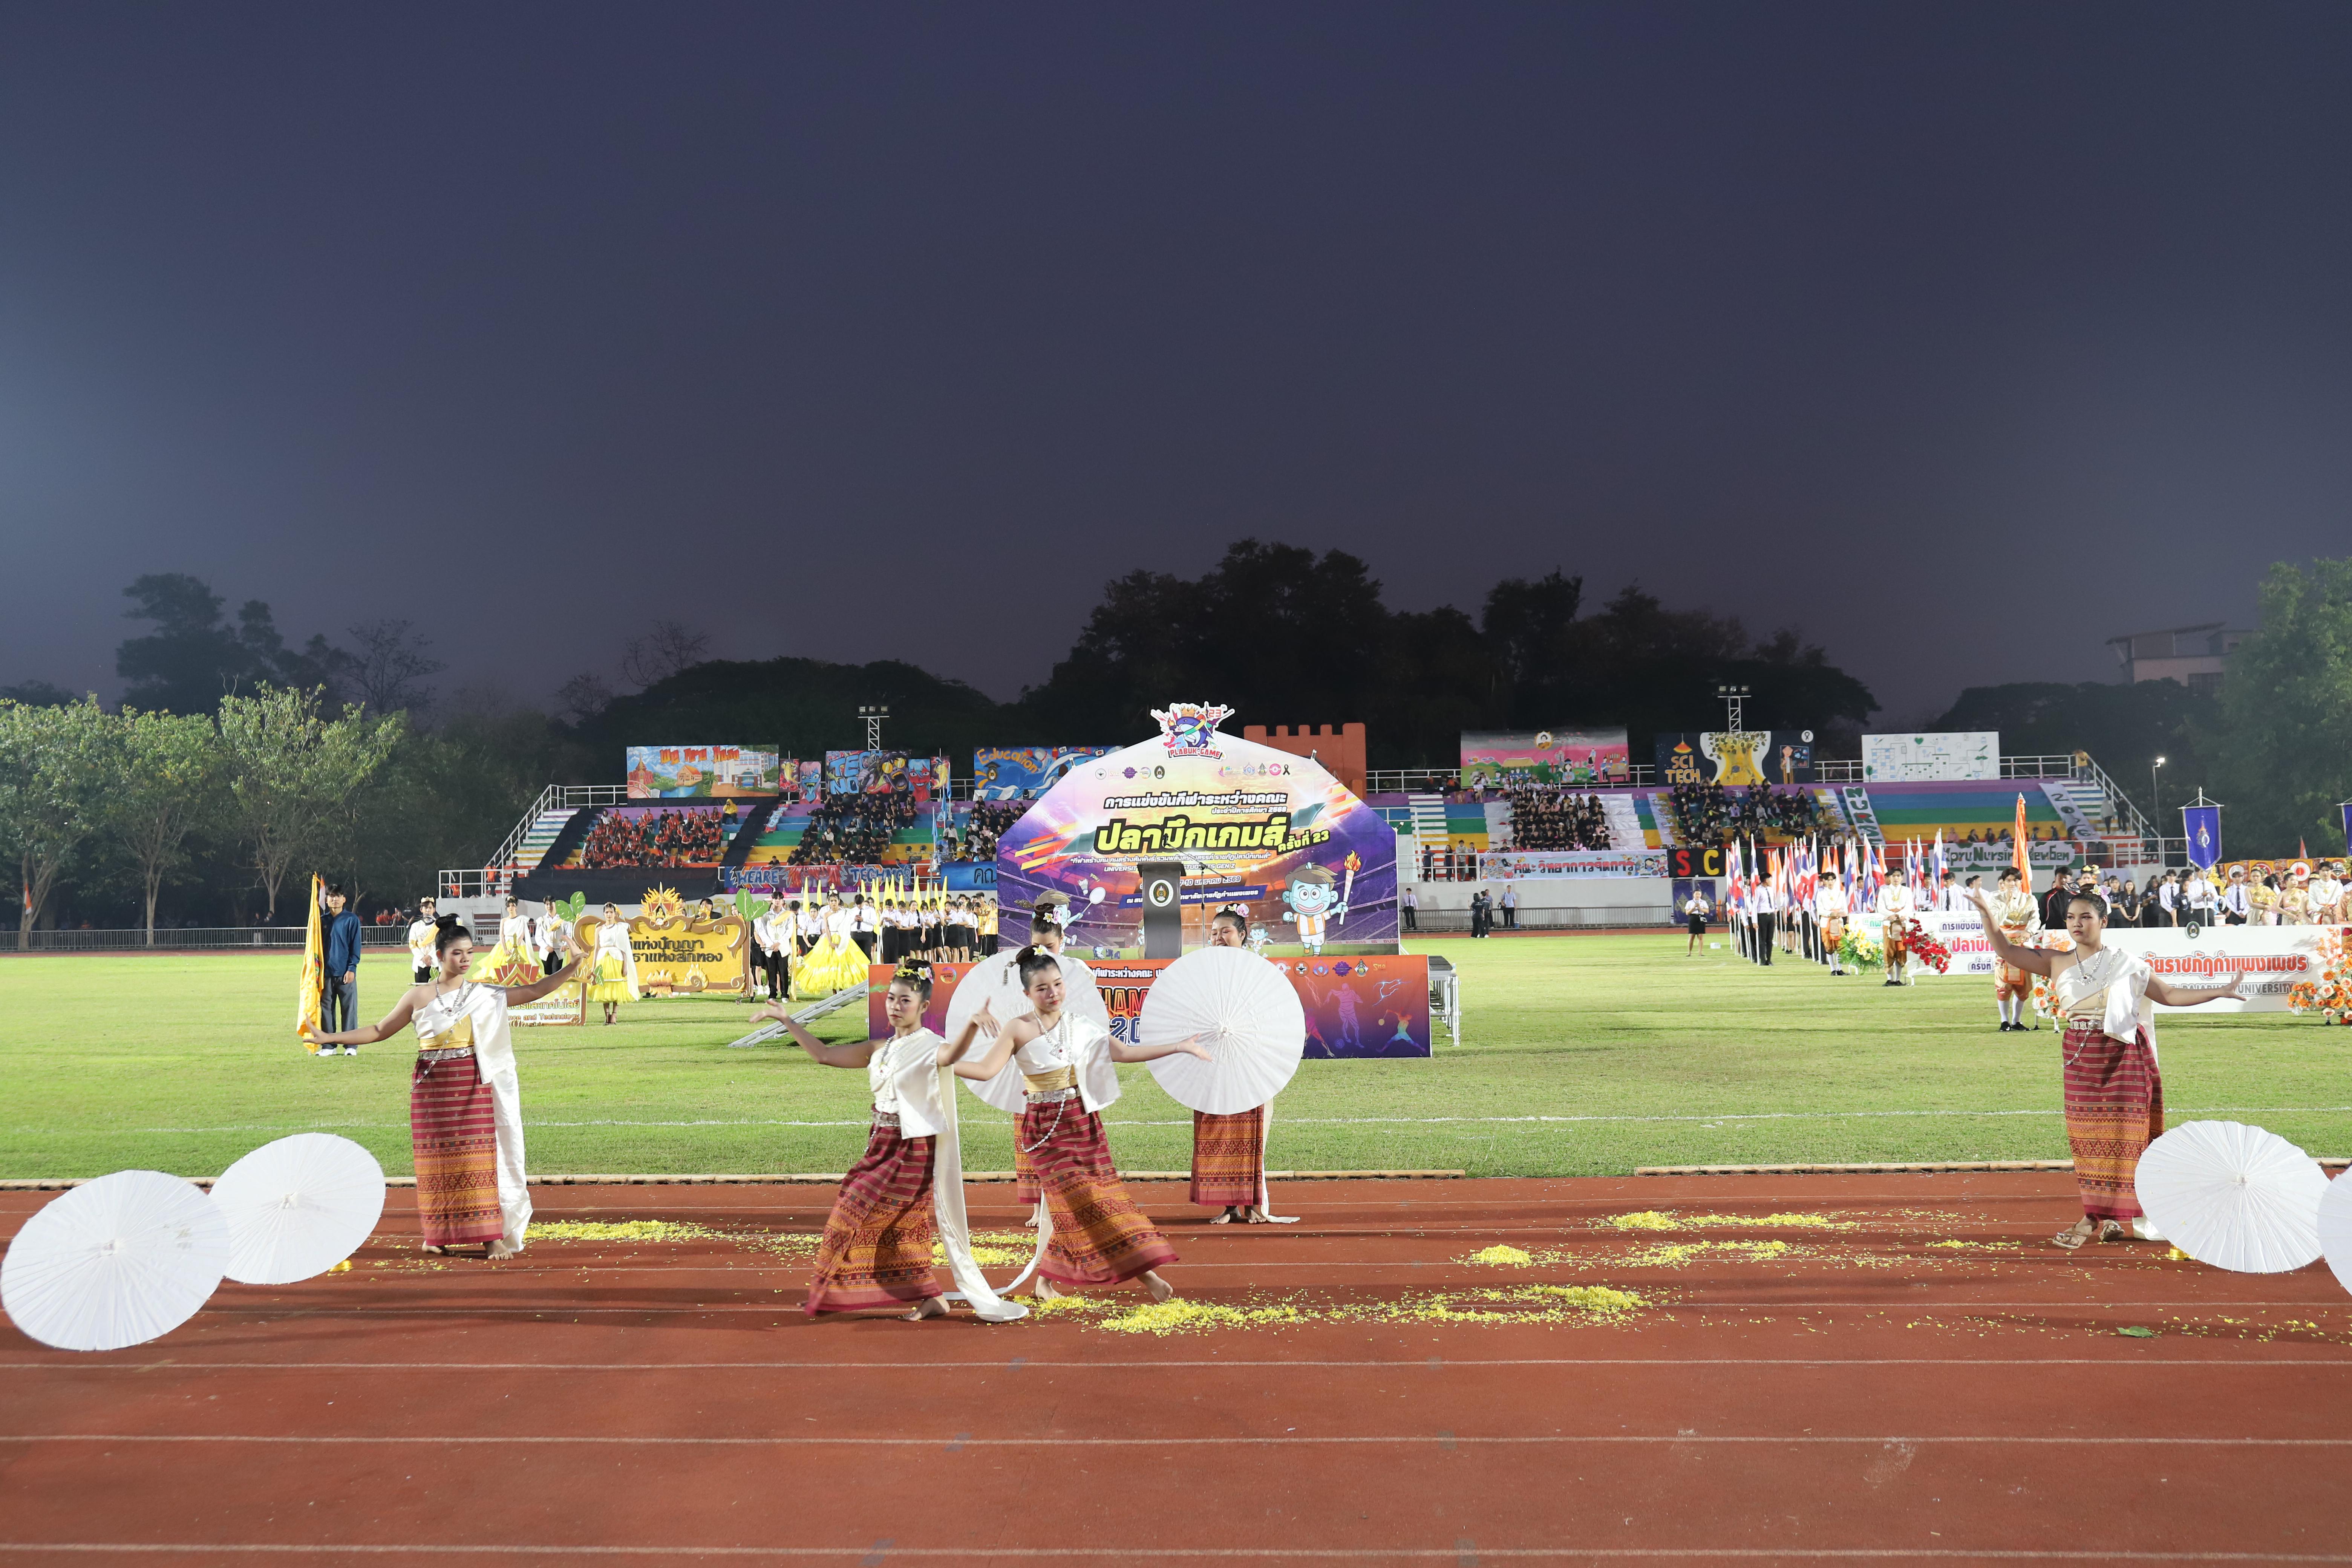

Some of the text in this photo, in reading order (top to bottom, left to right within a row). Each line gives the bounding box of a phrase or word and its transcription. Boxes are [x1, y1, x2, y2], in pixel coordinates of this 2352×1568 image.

[1209, 709, 1221, 717] 23
[1170, 748, 1220, 758] PLABUK GAME
[977, 747, 1038, 773] Education
[1671, 755, 1694, 769] SCI
[1664, 768, 1701, 784] TECH
[1104, 790, 1287, 809] การแข่งขันกีฬาระหว่างคณะ
[1278, 830, 1329, 852] ครั้งที่ 23
[1973, 847, 2013, 861] Nursin
[1514, 863, 1536, 874] คณะ
[1222, 875, 1241, 884] 2569
[1181, 890, 1258, 899] ทยาลัยราชภัฏกำแพงเพชร
[1942, 920, 1984, 931] การแข่งขัน
[2237, 983, 2293, 994] UNIVERSITY
